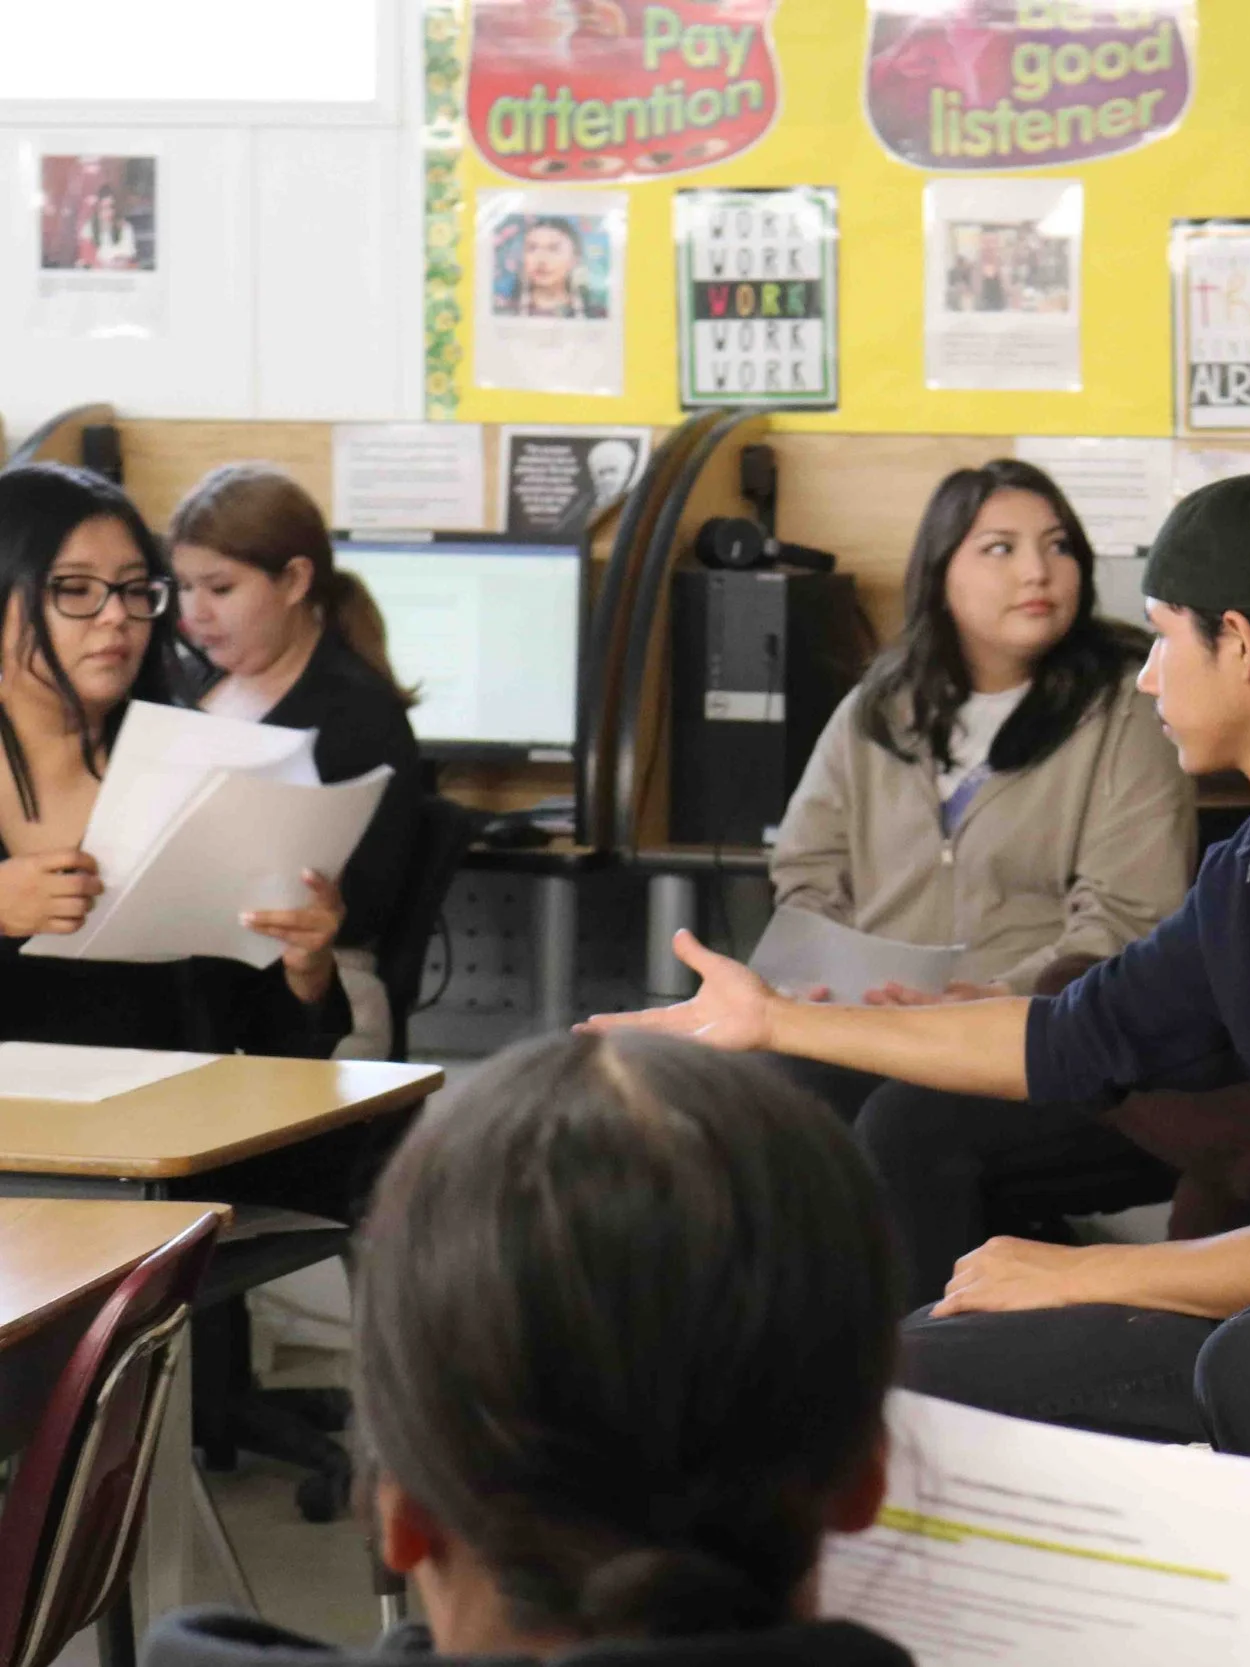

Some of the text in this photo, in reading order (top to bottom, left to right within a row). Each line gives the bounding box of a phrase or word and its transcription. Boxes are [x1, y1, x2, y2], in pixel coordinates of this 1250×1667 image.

[643, 6, 756, 77] Pay
[1011, 20, 1174, 102] good
[488, 79, 765, 156] attention
[930, 86, 1165, 158] listener
[708, 247, 804, 275] WORK
[707, 283, 806, 317] WORK
[710, 321, 806, 353] WORK
[710, 359, 806, 391] WORK
